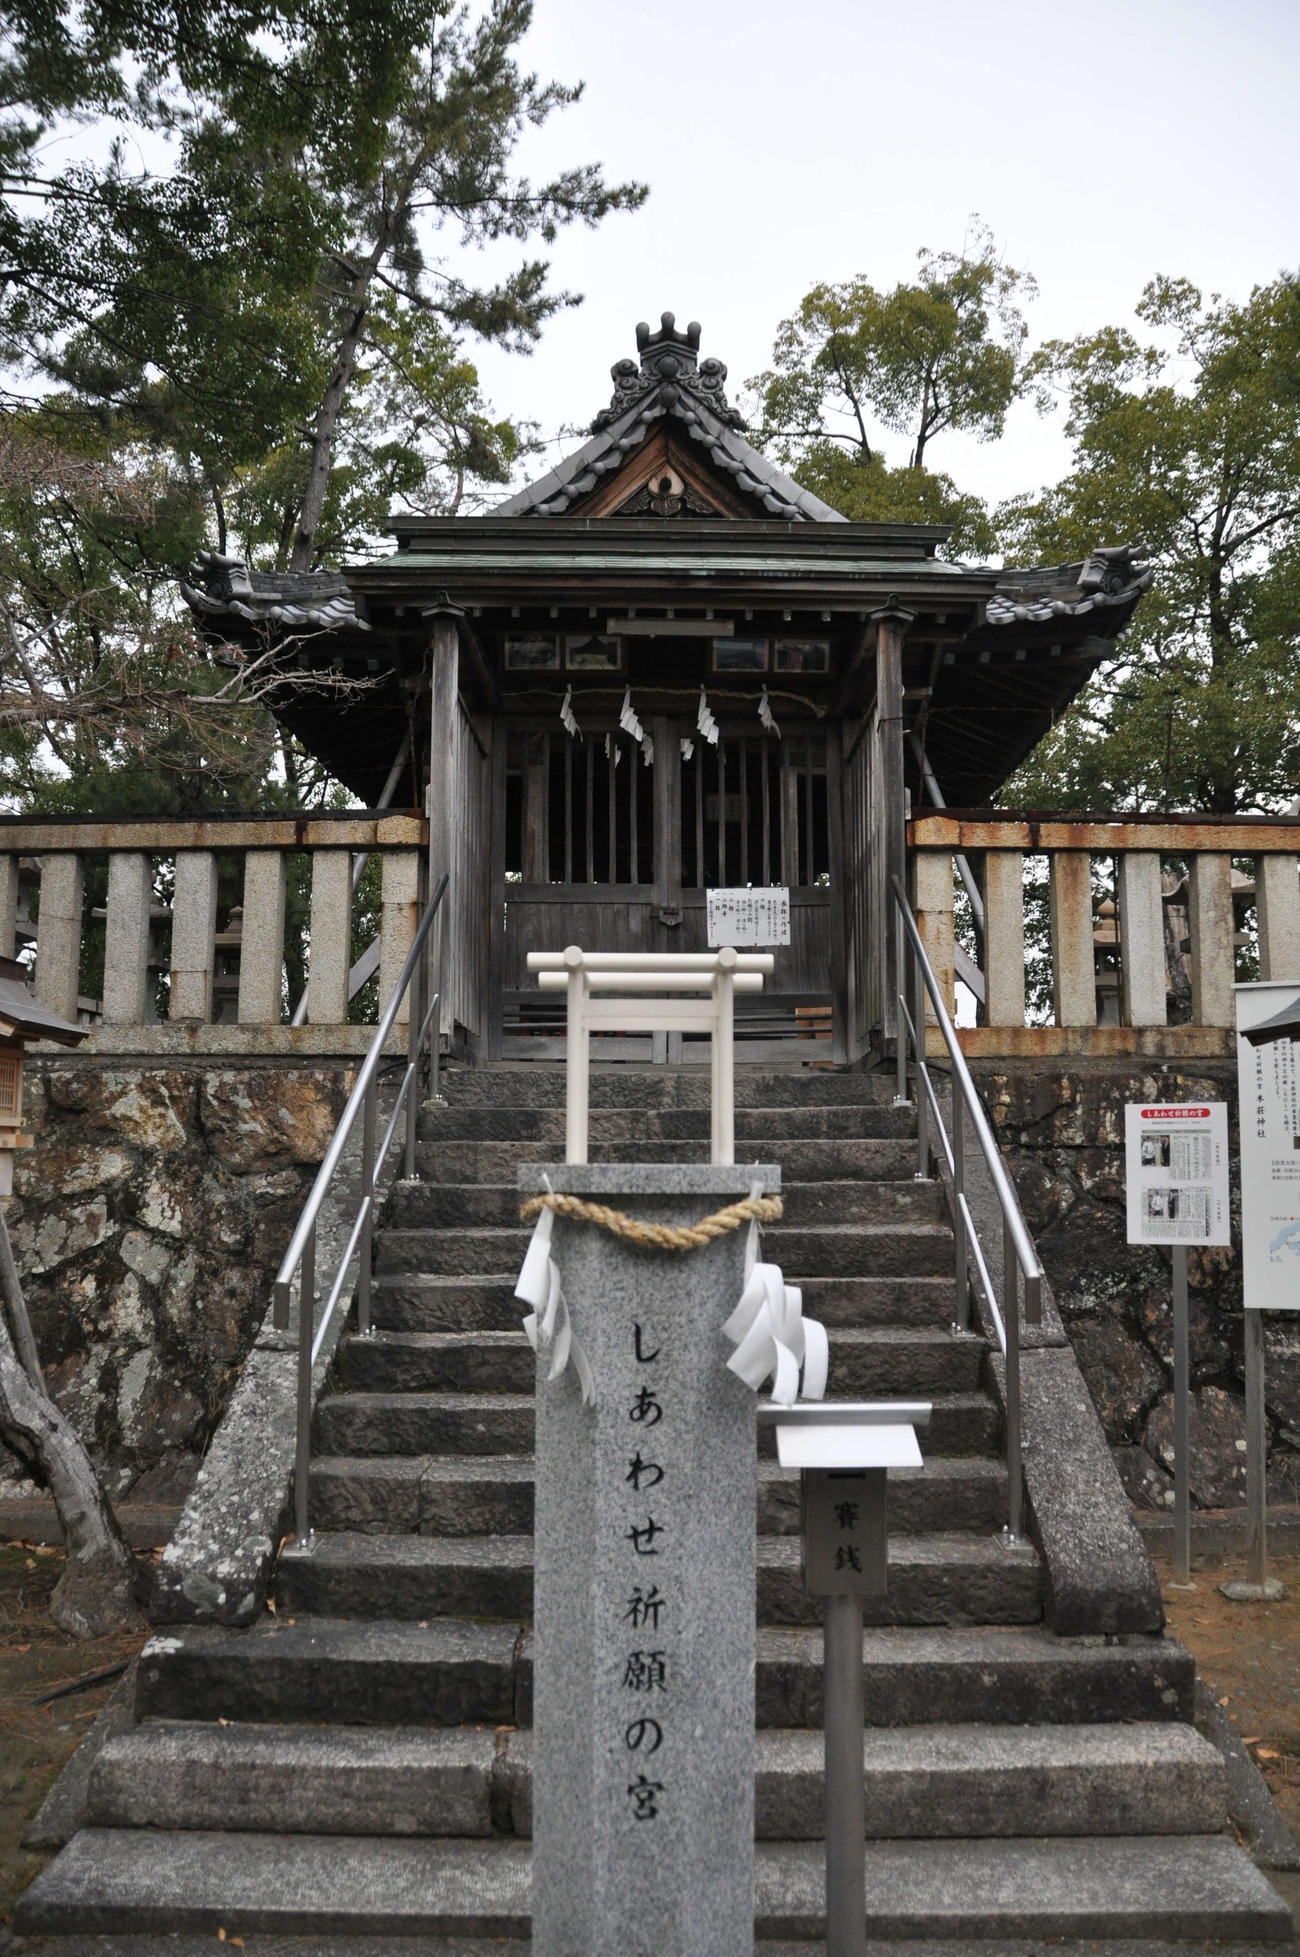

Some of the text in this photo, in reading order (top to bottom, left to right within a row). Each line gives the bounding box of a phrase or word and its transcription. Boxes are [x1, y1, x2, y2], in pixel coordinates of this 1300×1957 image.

[1147, 1110, 1204, 1118] しあわせ祈願の宮
[623, 1322, 667, 1821] しあわせ祈願の宮
